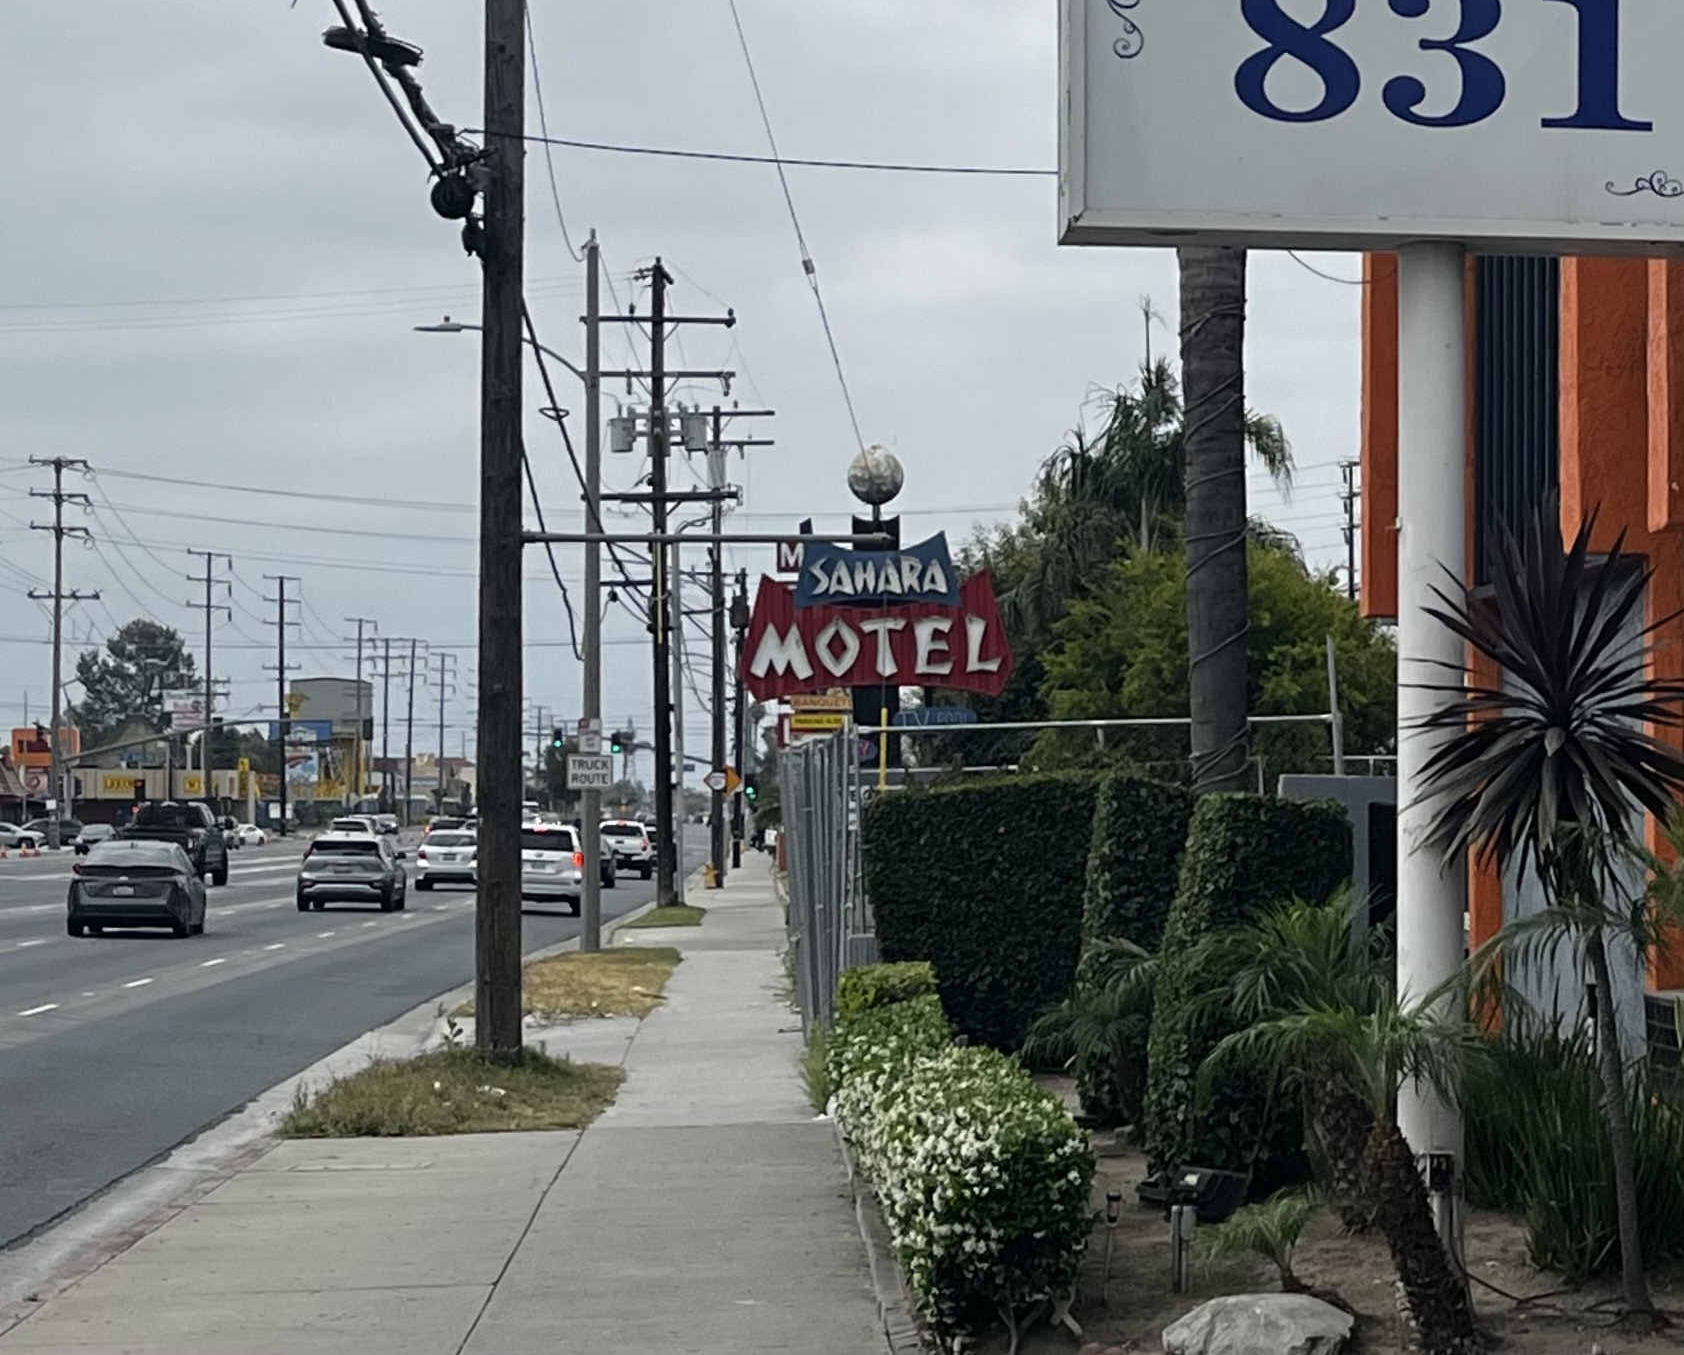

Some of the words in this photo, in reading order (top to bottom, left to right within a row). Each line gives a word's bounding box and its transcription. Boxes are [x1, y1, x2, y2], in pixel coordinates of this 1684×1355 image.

[808, 556, 949, 595] SAHARA
[750, 614, 1002, 681] MOTEL
[571, 758, 609, 771] TRUCK
[570, 772, 609, 785] ROUTE
